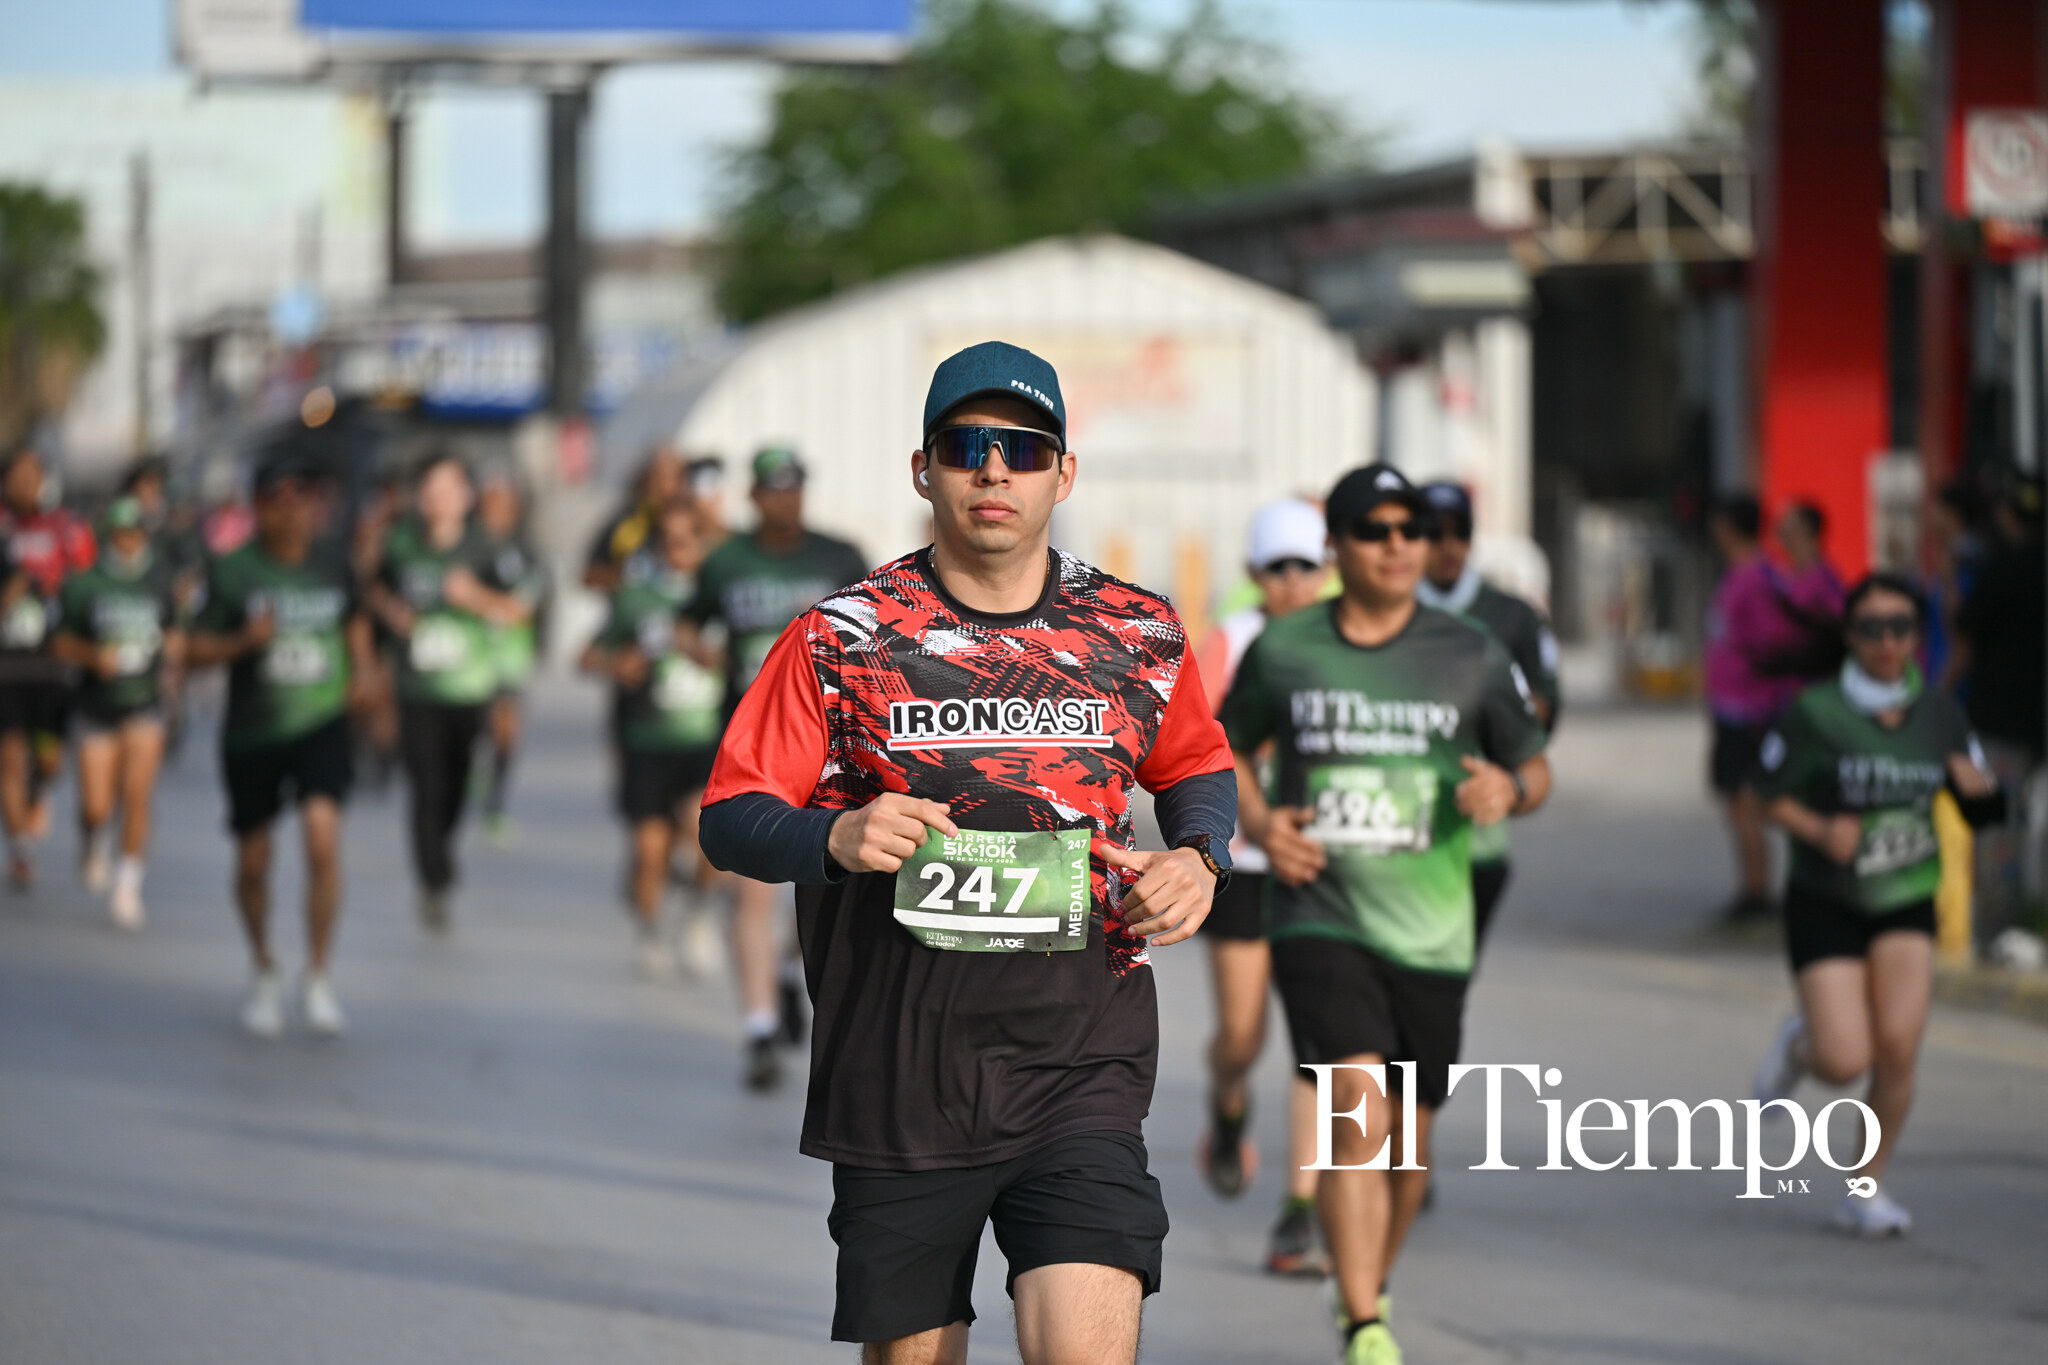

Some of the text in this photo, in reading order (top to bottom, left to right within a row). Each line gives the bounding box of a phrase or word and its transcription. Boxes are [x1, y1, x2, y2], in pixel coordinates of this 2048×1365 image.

[1010, 379, 1054, 410] PGA TOUR
[890, 699, 1108, 737] IRONCAST
[1326, 689, 1460, 741] Tiempo
[1315, 789, 1400, 827] 596
[1067, 839, 1087, 850] 247
[917, 862, 1040, 914] 247
[1067, 858, 1084, 937] MEDALLA
[934, 932, 963, 944] Tiempo
